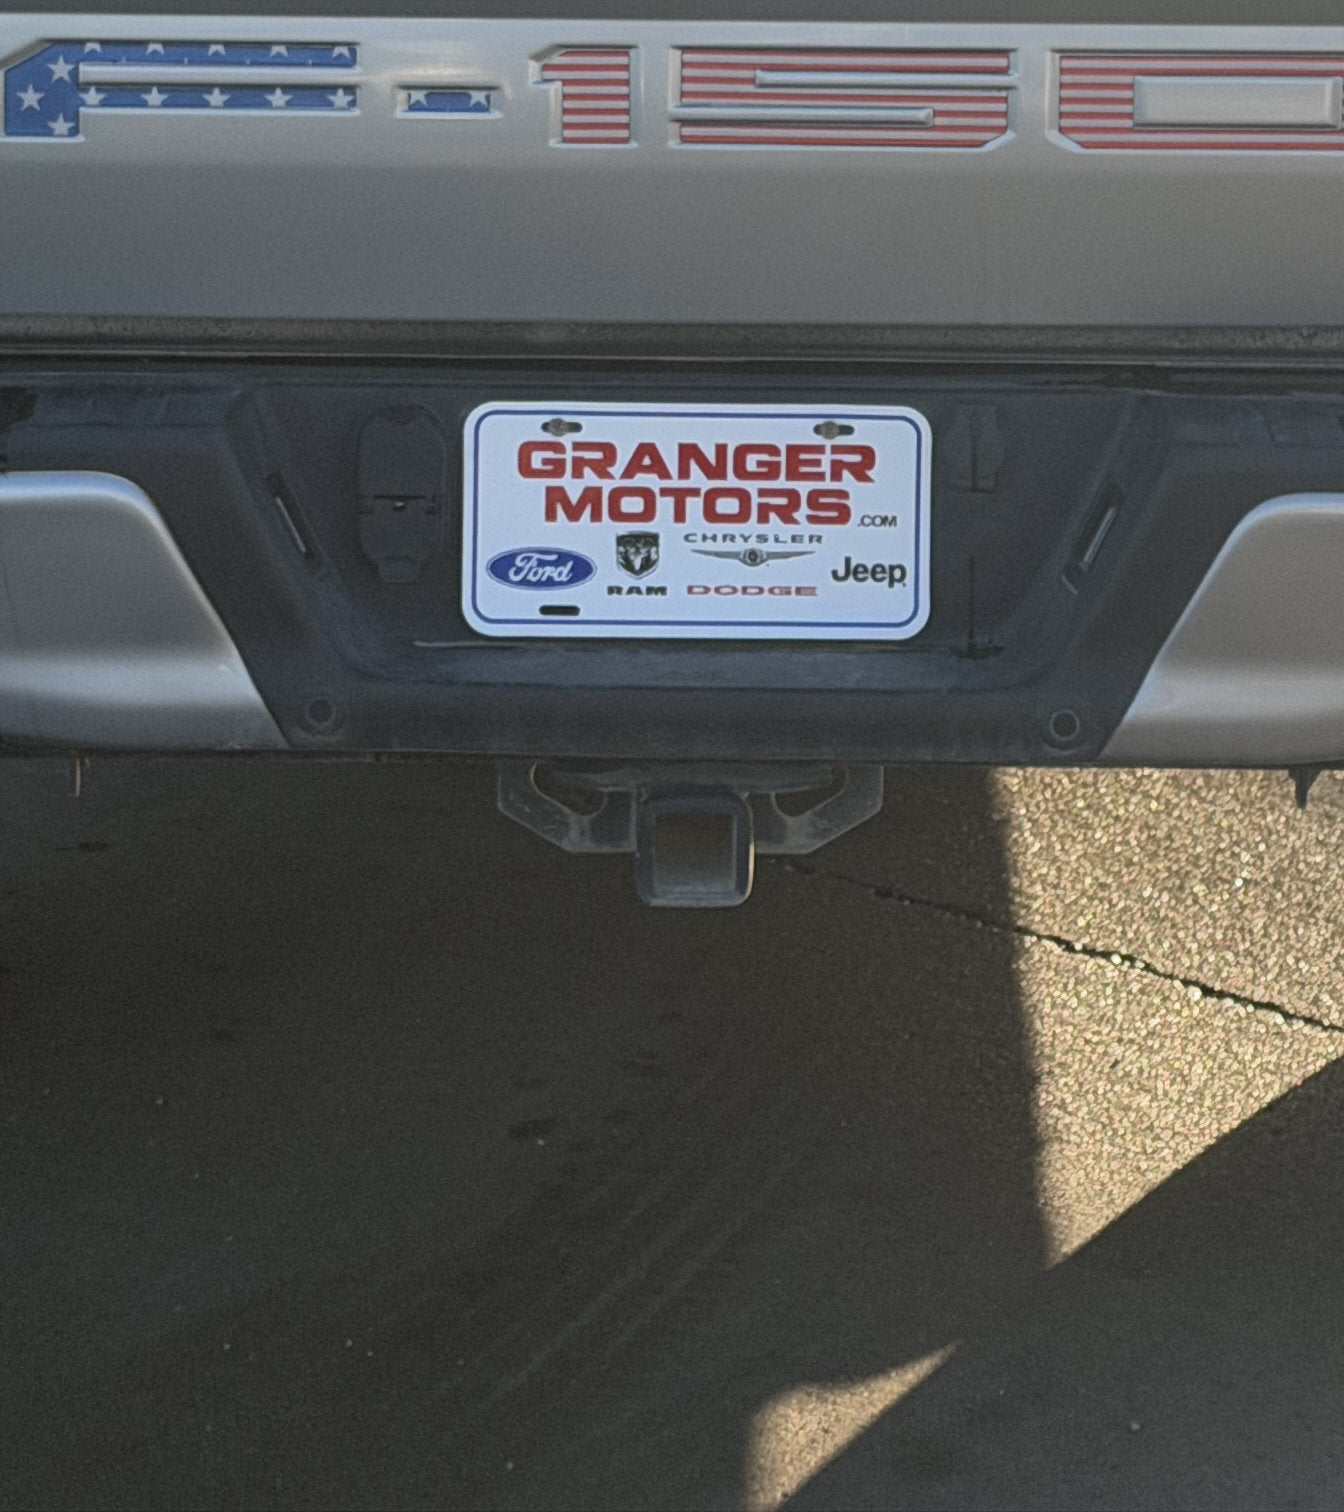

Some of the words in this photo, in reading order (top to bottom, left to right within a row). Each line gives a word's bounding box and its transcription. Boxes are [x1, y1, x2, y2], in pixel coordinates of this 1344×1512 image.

[517, 440, 877, 483] GRANGER
[544, 485, 852, 526] MOTORS
[683, 532, 824, 545] CHRYSLER
[508, 552, 573, 584] Ford
[831, 555, 907, 589] Jeep
[607, 585, 668, 597] RAM
[687, 584, 819, 598] DODGE
